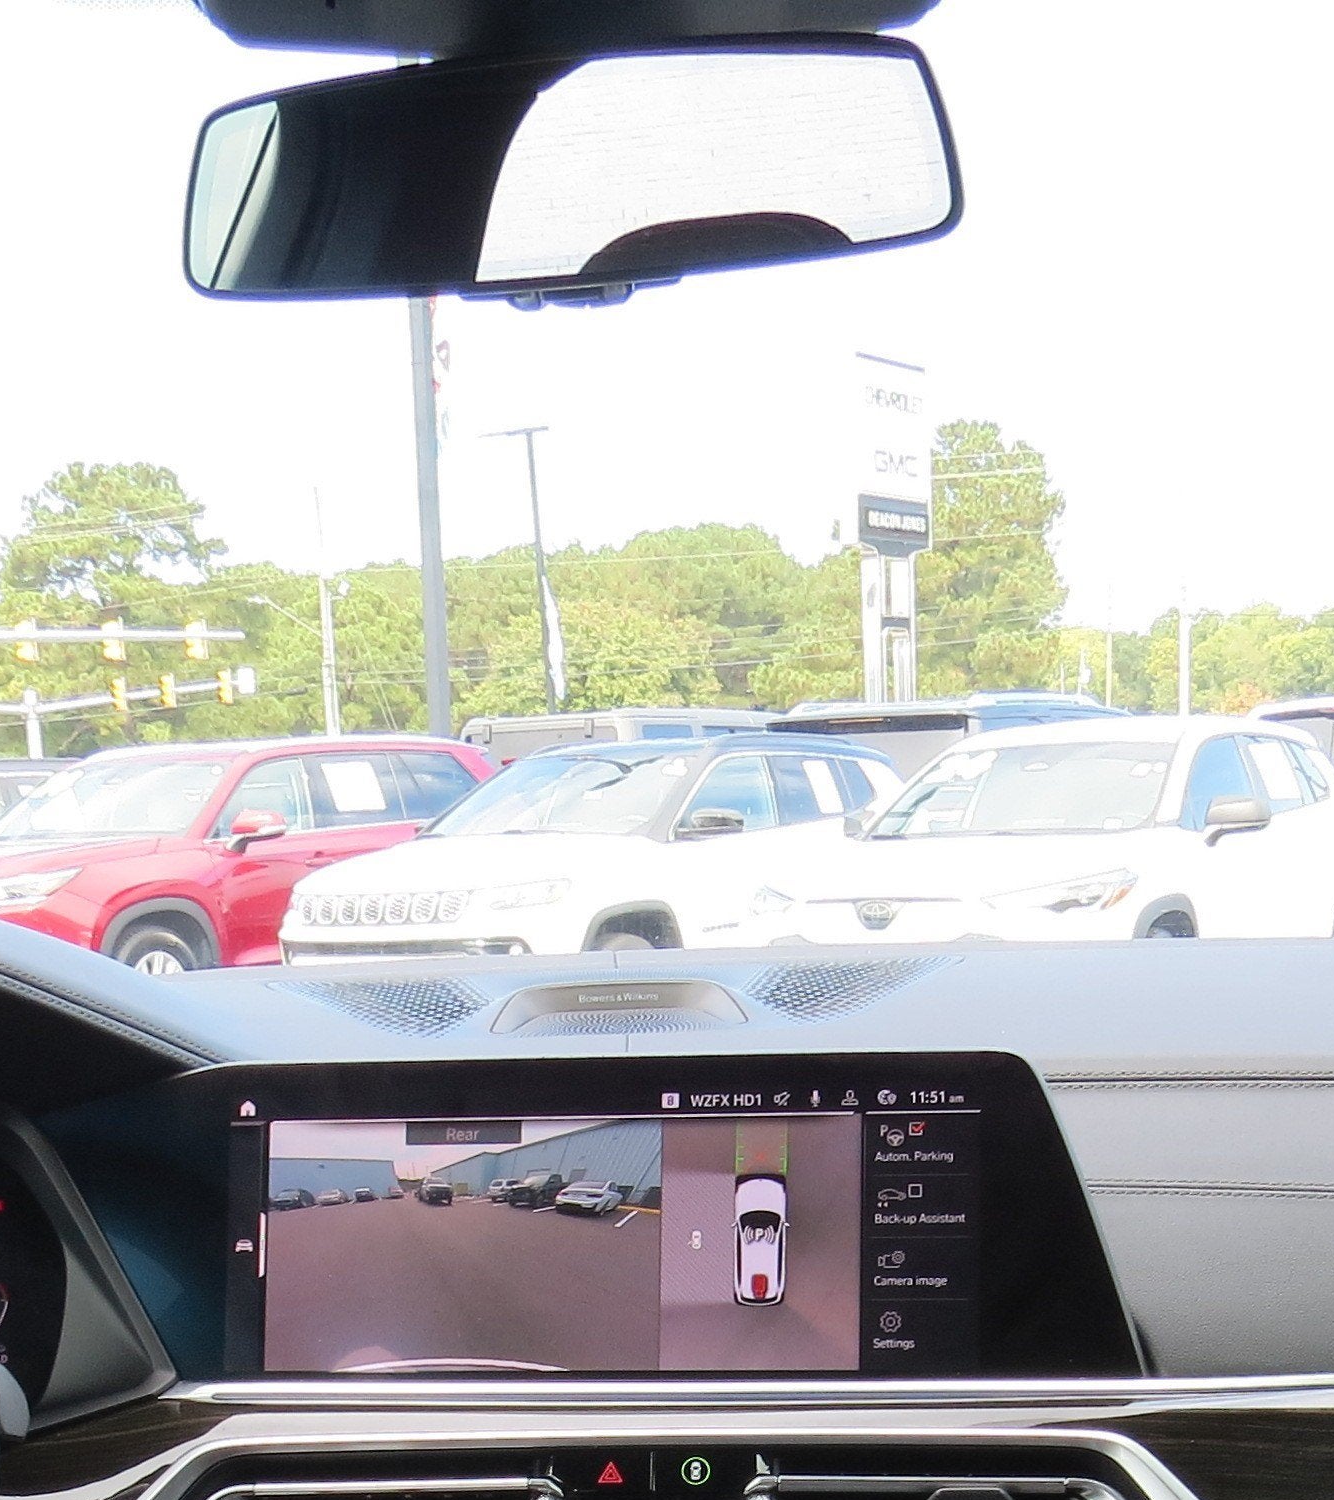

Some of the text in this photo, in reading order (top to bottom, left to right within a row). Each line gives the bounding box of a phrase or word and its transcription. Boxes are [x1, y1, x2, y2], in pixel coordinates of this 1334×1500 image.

[874, 450, 918, 478] GMC
[690, 1093, 730, 1107] WZFX
[733, 1092, 763, 1107] HD1
[909, 1090, 965, 1105] 11:51 am
[446, 1126, 480, 1143] Rear
[873, 1150, 955, 1164] Autom. Parking
[873, 1212, 966, 1226] Back-up Assistant
[873, 1275, 949, 1289] Camera image
[872, 1336, 916, 1351] Settings
